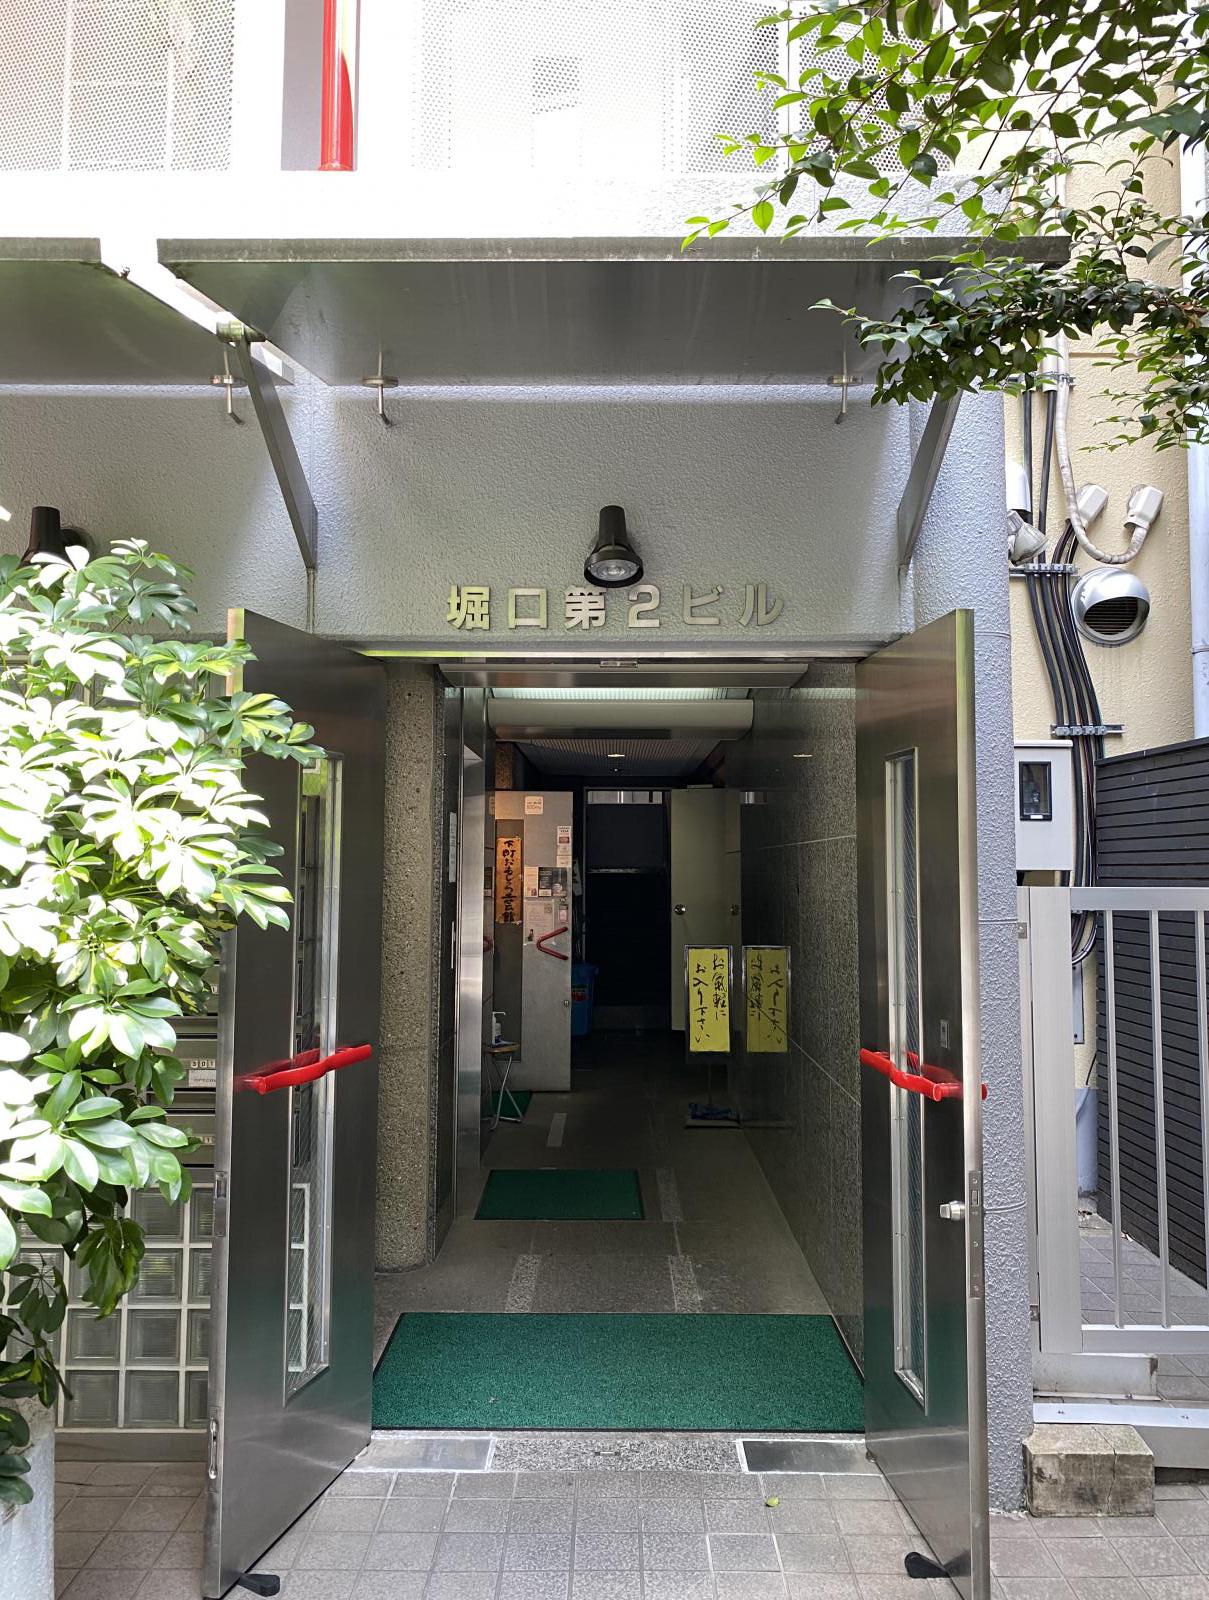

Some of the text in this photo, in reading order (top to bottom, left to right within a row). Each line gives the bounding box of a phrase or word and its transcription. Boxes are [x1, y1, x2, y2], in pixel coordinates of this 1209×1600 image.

[447, 584, 783, 629] 堀口第2ビル
[692, 963, 710, 1043] お入り下さい
